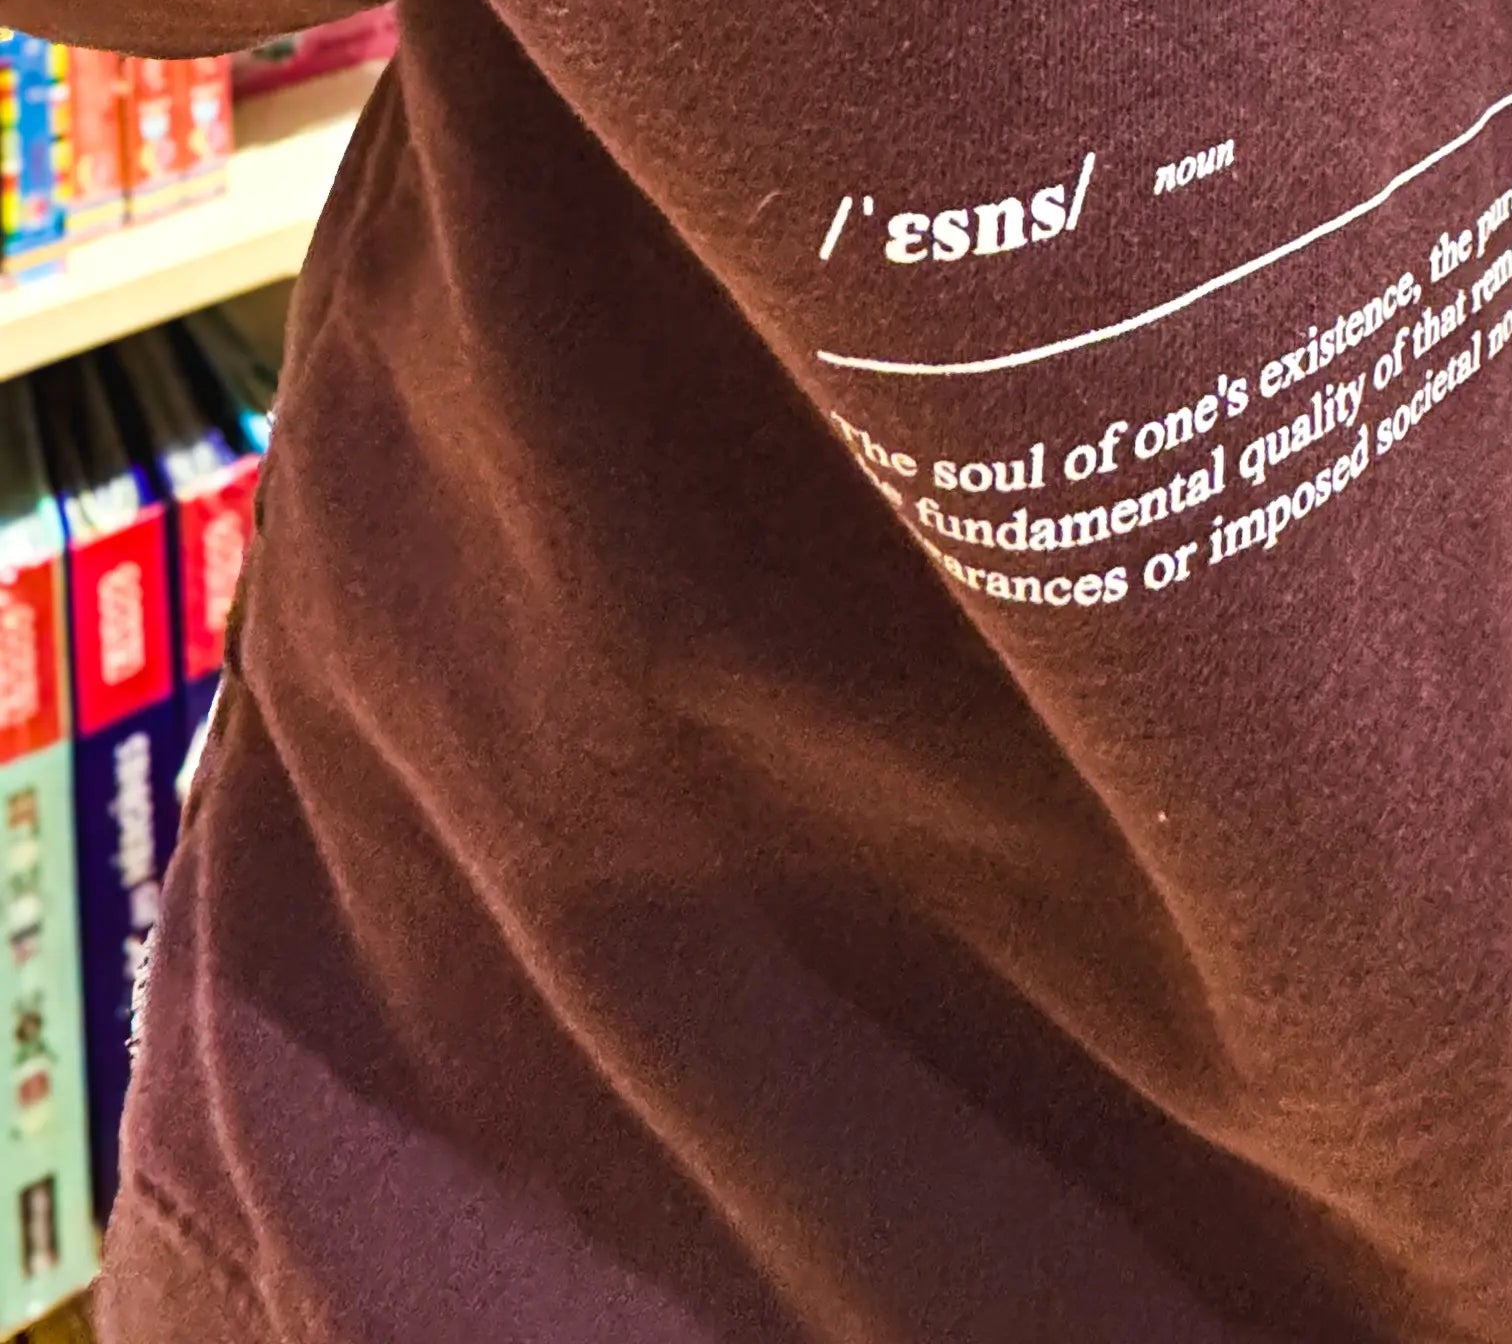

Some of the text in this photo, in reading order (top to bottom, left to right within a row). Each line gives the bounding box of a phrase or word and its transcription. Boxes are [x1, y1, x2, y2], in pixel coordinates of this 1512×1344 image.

[1154, 138, 1235, 196] noun
[915, 444, 1225, 551] fundamental
[1239, 372, 1366, 486] quality
[1373, 326, 1410, 390] of
[1411, 289, 1467, 360] that
[934, 442, 1046, 493] soul
[1065, 421, 1128, 481] of
[1134, 374, 1250, 460] one's
[1260, 271, 1422, 399] existence,
[1428, 230, 1474, 284] the
[1143, 542, 1198, 592] or
[1209, 423, 1370, 565] imposed
[1376, 330, 1481, 455] societal
